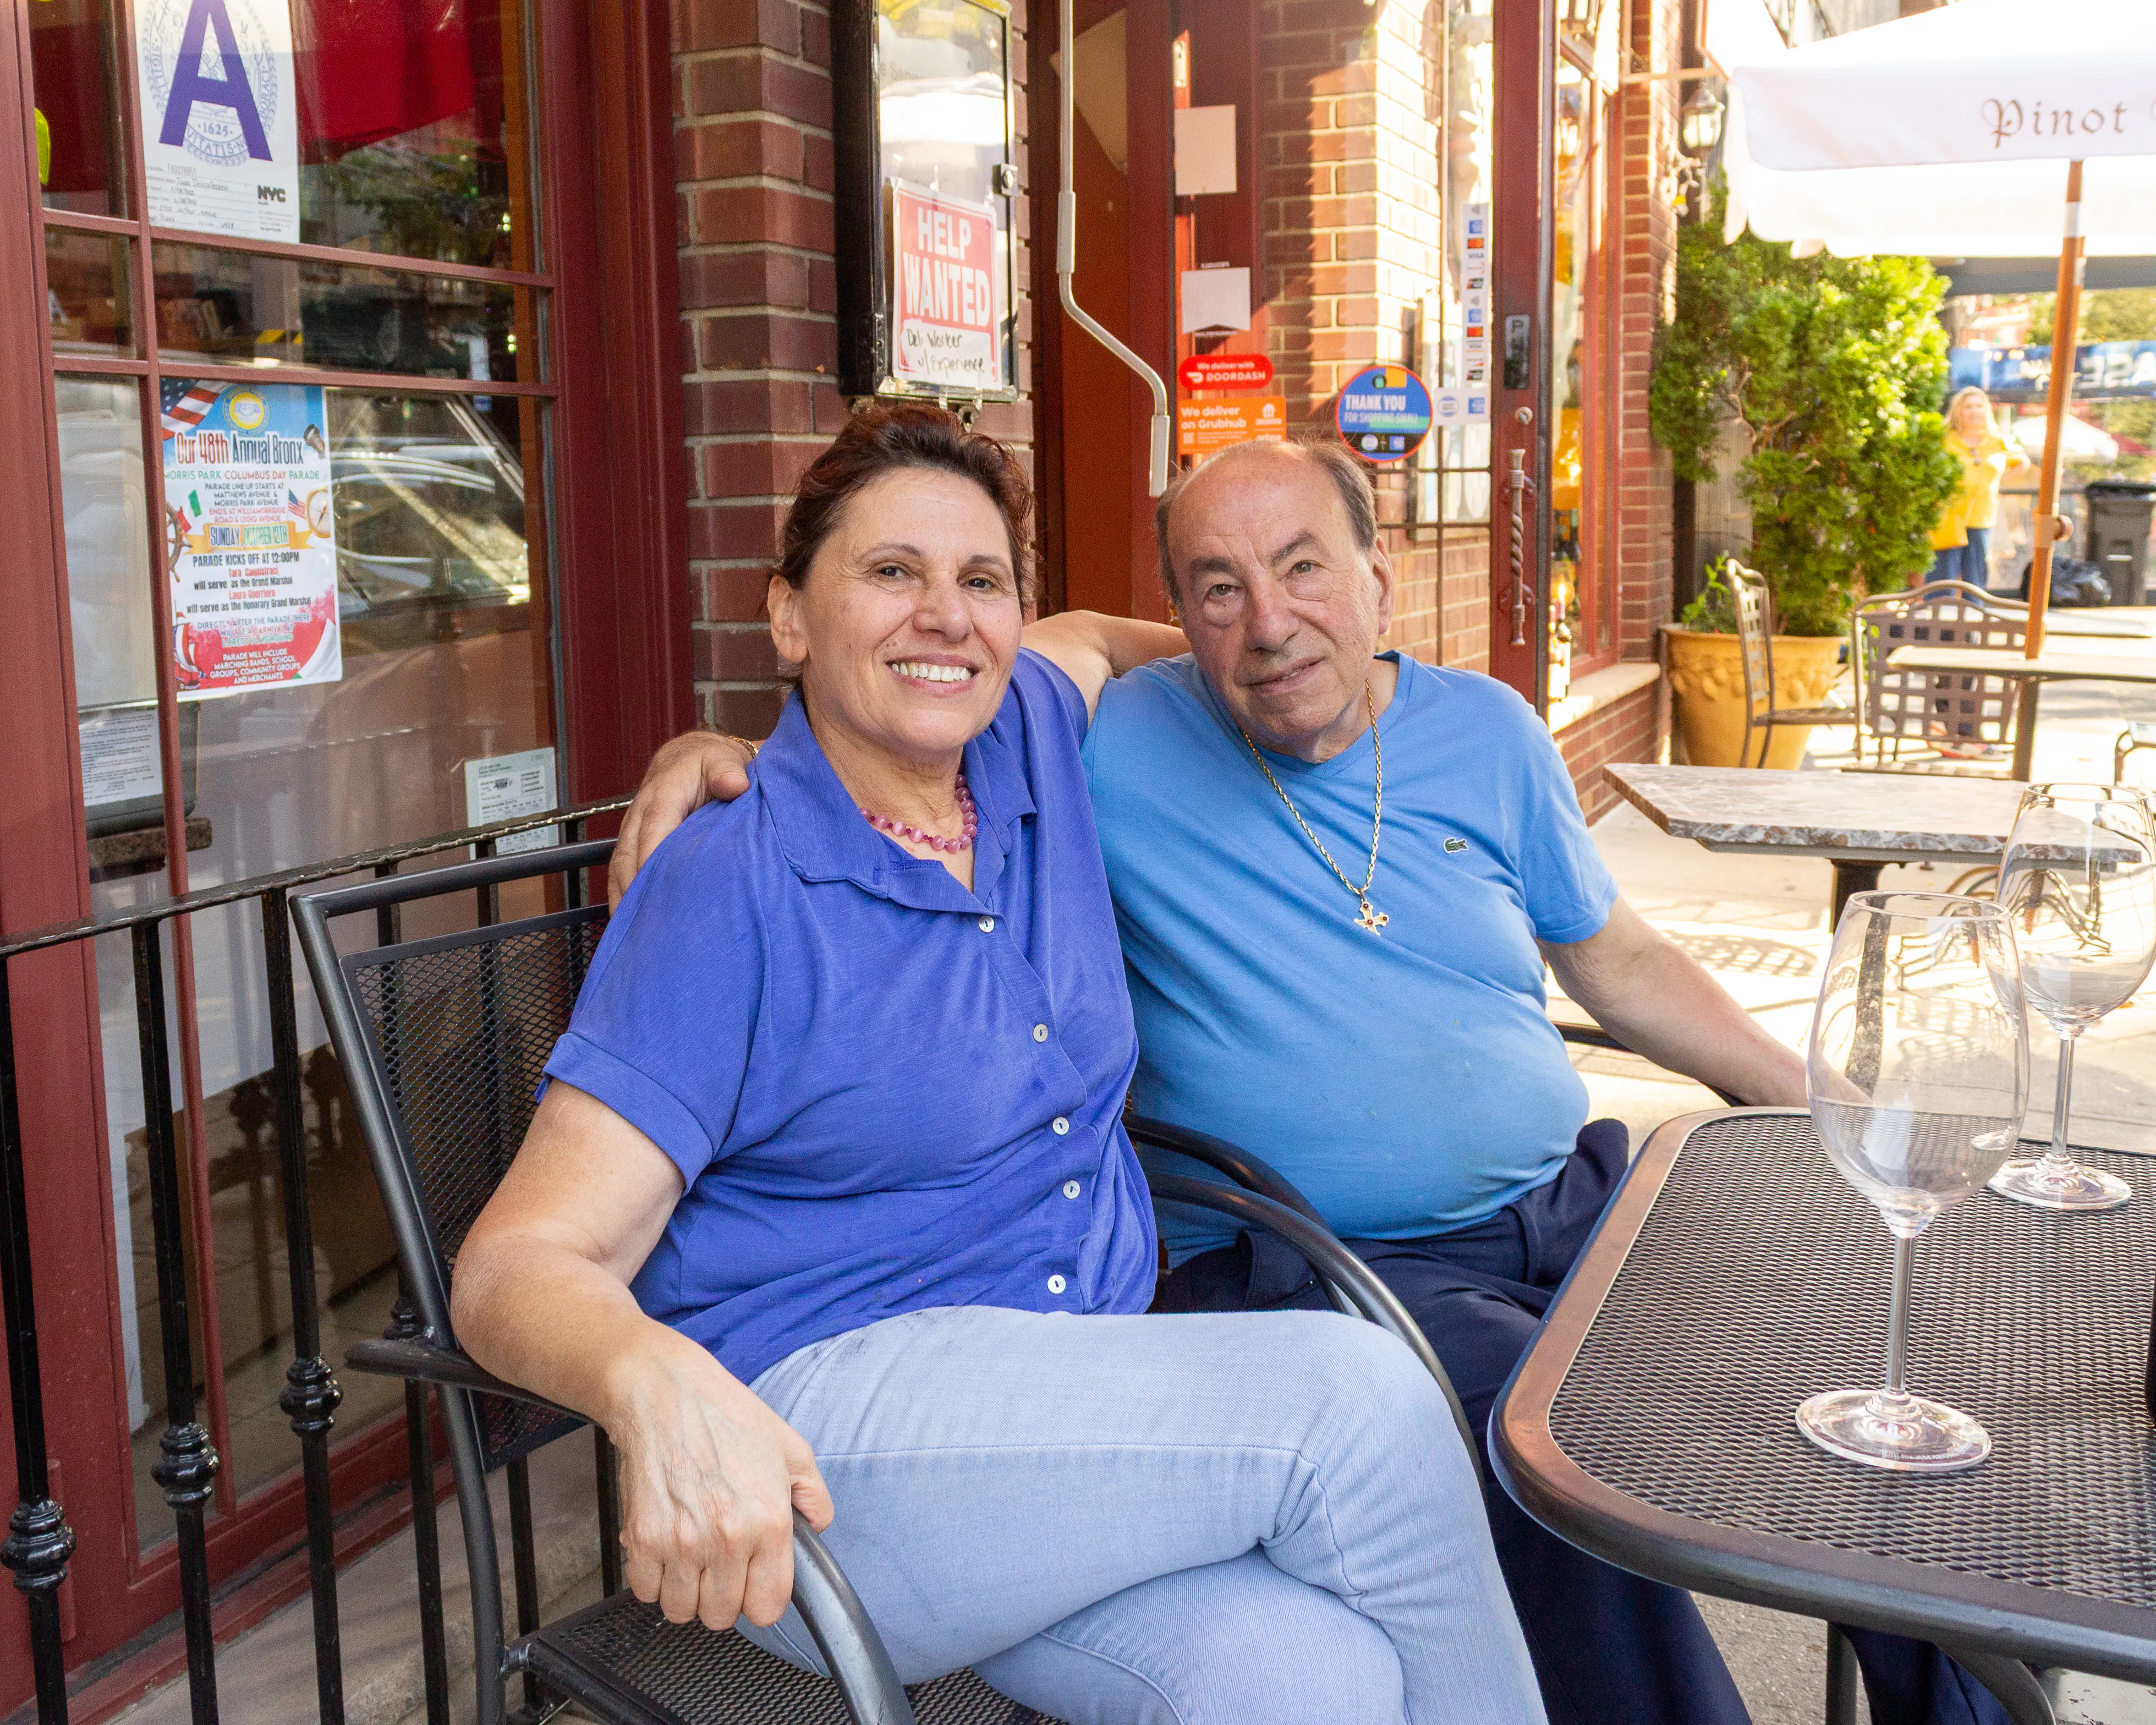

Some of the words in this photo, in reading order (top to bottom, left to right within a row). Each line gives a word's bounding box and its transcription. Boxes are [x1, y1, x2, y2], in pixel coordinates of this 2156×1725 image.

[159, 0, 273, 161] A
[203, 122, 228, 136] 1625
[1981, 98, 2128, 149] Pinot
[257, 184, 286, 203] NYC
[918, 206, 972, 261] HELP
[903, 251, 991, 327] WANTED
[907, 328, 923, 347] Deli
[927, 330, 963, 348] Worker
[1206, 371, 1266, 382] DOORDASH
[1345, 395, 1383, 410] THANK
[1384, 395, 1406, 411] YOU
[1181, 407, 1200, 417] We
[1202, 406, 1240, 417] deliver
[1198, 418, 1247, 429] Grubhub
[177, 432, 196, 464] Our
[199, 432, 229, 464] 48th
[233, 433, 270, 464] Annual
[272, 434, 304, 464] Bronx
[164, 470, 195, 480] MORRIS
[198, 470, 222, 480] PARK
[224, 470, 270, 480] COLUMBUS
[272, 470, 287, 480] DAY
[289, 470, 320, 480] PARADE
[272, 524, 288, 544] 12TH
[193, 555, 223, 567] PARADE
[226, 554, 246, 566] KICKS
[248, 553, 259, 565] OFF
[262, 552, 269, 563] AT
[271, 551, 300, 563] 12:00PM
[228, 568, 242, 577] Tara
[194, 581, 206, 590] will
[207, 581, 227, 590] serve
[240, 578, 250, 587] the
[251, 577, 268, 587] Grand
[270, 576, 293, 585] Marshal
[229, 590, 246, 600] Laura
[186, 604, 198, 614] will
[200, 604, 219, 612] serve
[221, 603, 229, 611] as
[231, 601, 242, 610] the
[243, 600, 270, 610] Honorary
[271, 598, 287, 607] Grand
[289, 596, 311, 606] Marshal
[198, 621, 229, 629] DIRECTLY
[232, 618, 253, 626] AFTER
[267, 615, 290, 623] PARADE
[221, 628, 237, 636] WILL
[254, 625, 284, 633] CARNIVAL
[222, 637, 248, 647] LORETO
[250, 634, 293, 644] PLAYGROUND
[223, 652, 248, 661] PARADE
[262, 648, 287, 657] INCLUDE
[213, 660, 248, 670] MARCHING
[271, 655, 296, 664] SCHOOL
[240, 665, 276, 676] COMMUNITY
[276, 662, 300, 671] GROUPS
[248, 672, 283, 682] MERCHANTS
